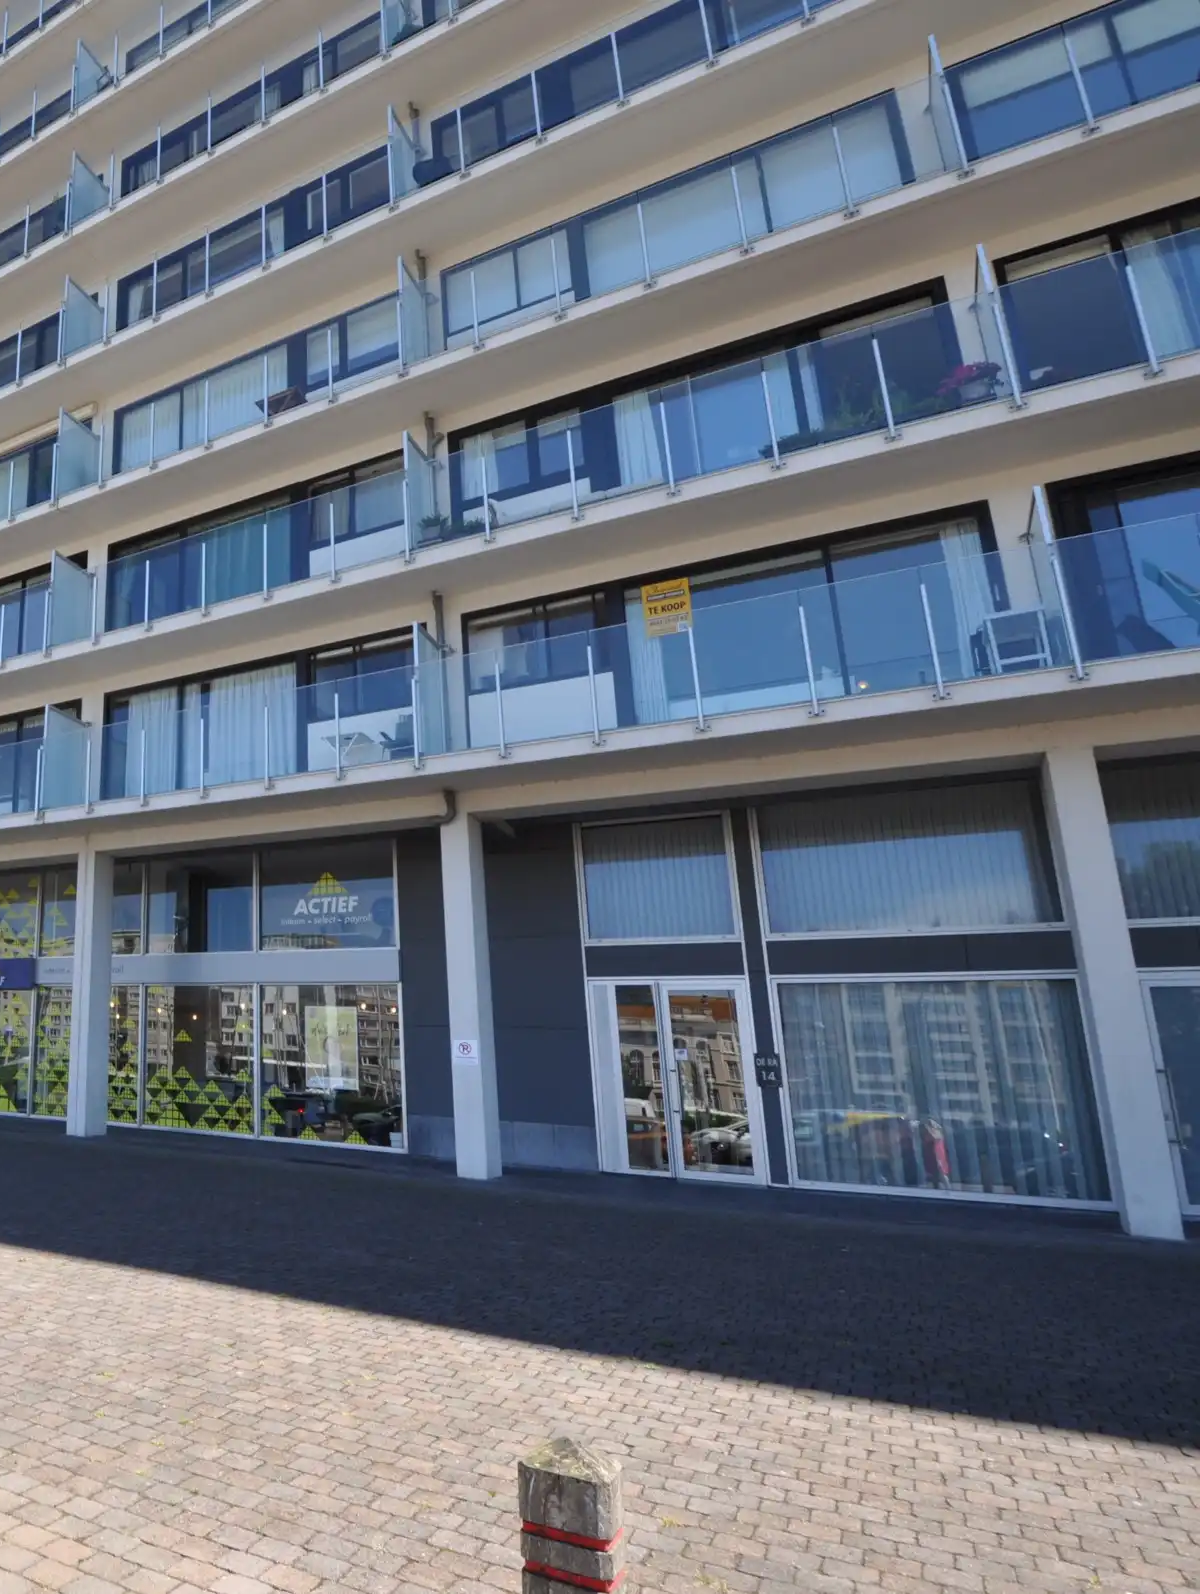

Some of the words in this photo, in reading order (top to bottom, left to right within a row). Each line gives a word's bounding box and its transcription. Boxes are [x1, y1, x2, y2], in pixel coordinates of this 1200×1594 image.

[648, 607, 659, 615] TE
[661, 601, 686, 613] KOOP
[293, 895, 359, 916] ACTIEF
[761, 1070, 777, 1081] 14
